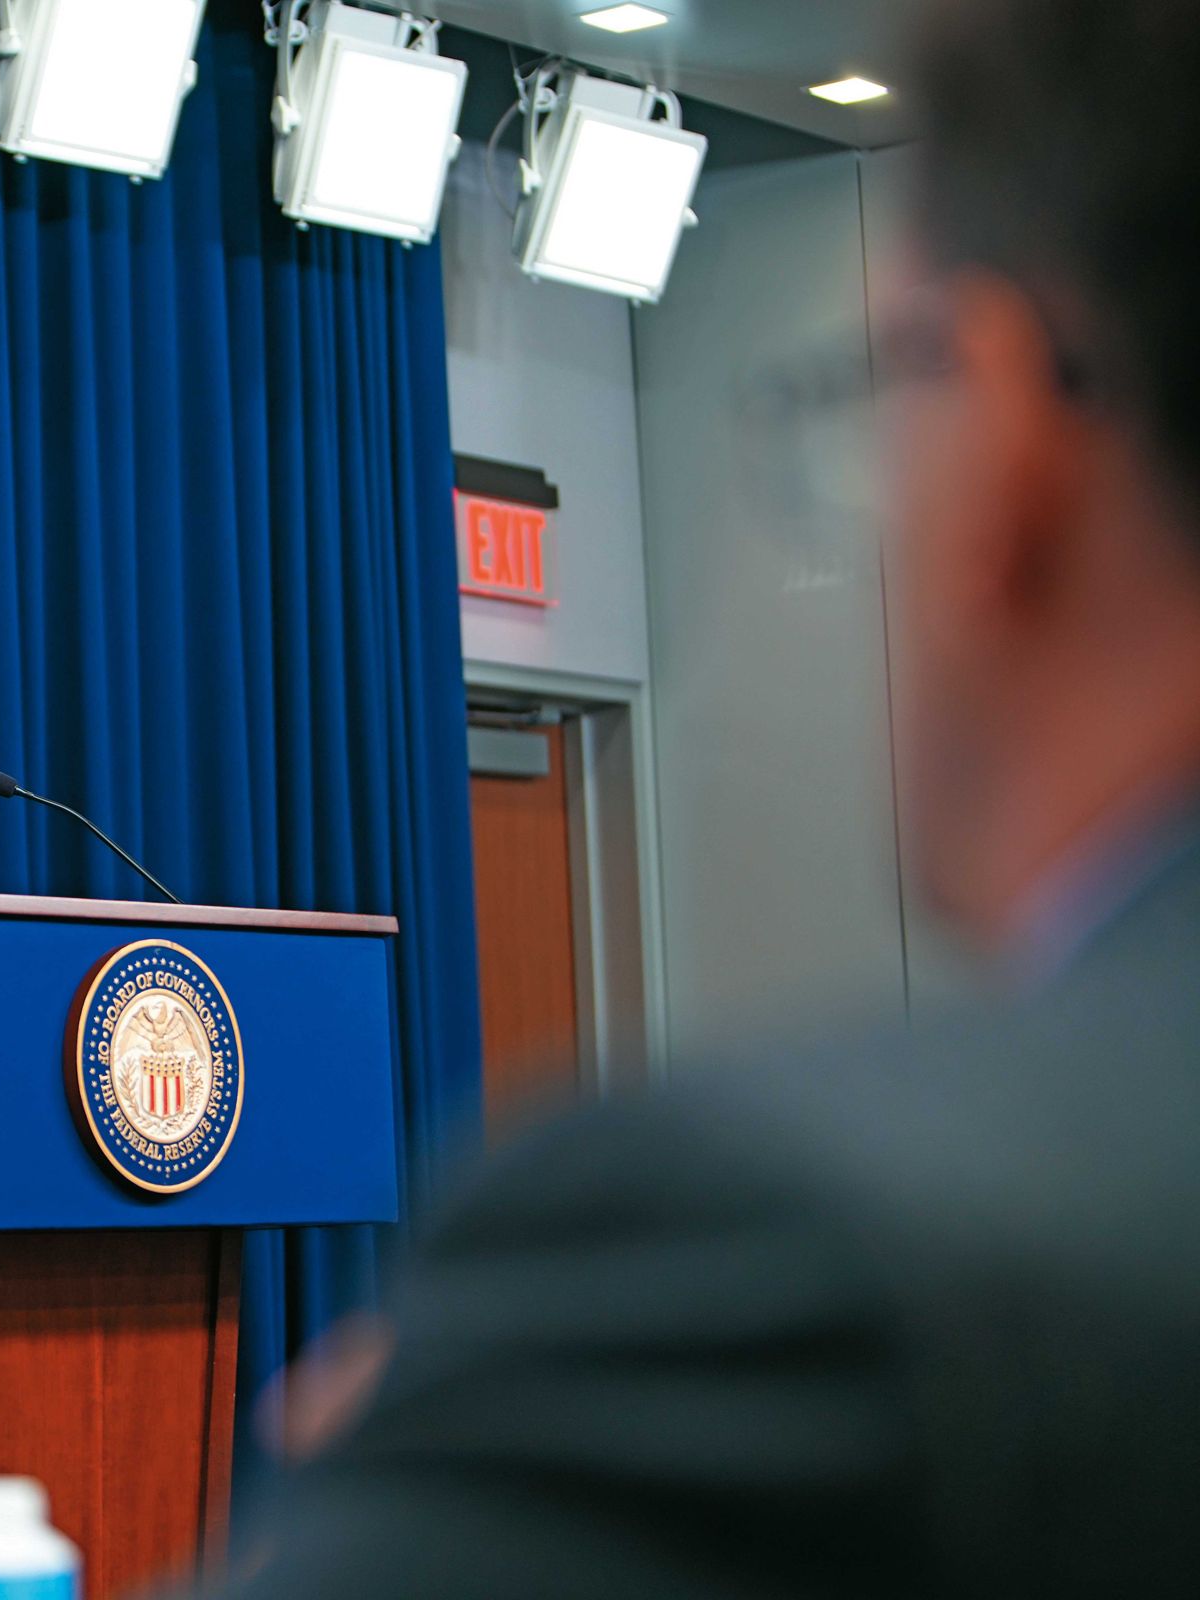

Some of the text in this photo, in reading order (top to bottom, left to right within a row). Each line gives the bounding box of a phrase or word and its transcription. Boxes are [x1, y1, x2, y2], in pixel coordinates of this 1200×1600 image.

[465, 499, 546, 593] EXIT
[102, 970, 220, 1042] BOARD OF GOVERNORS
[97, 1040, 225, 1161] OF THE FEDERAL RESERVE SYSTEM
